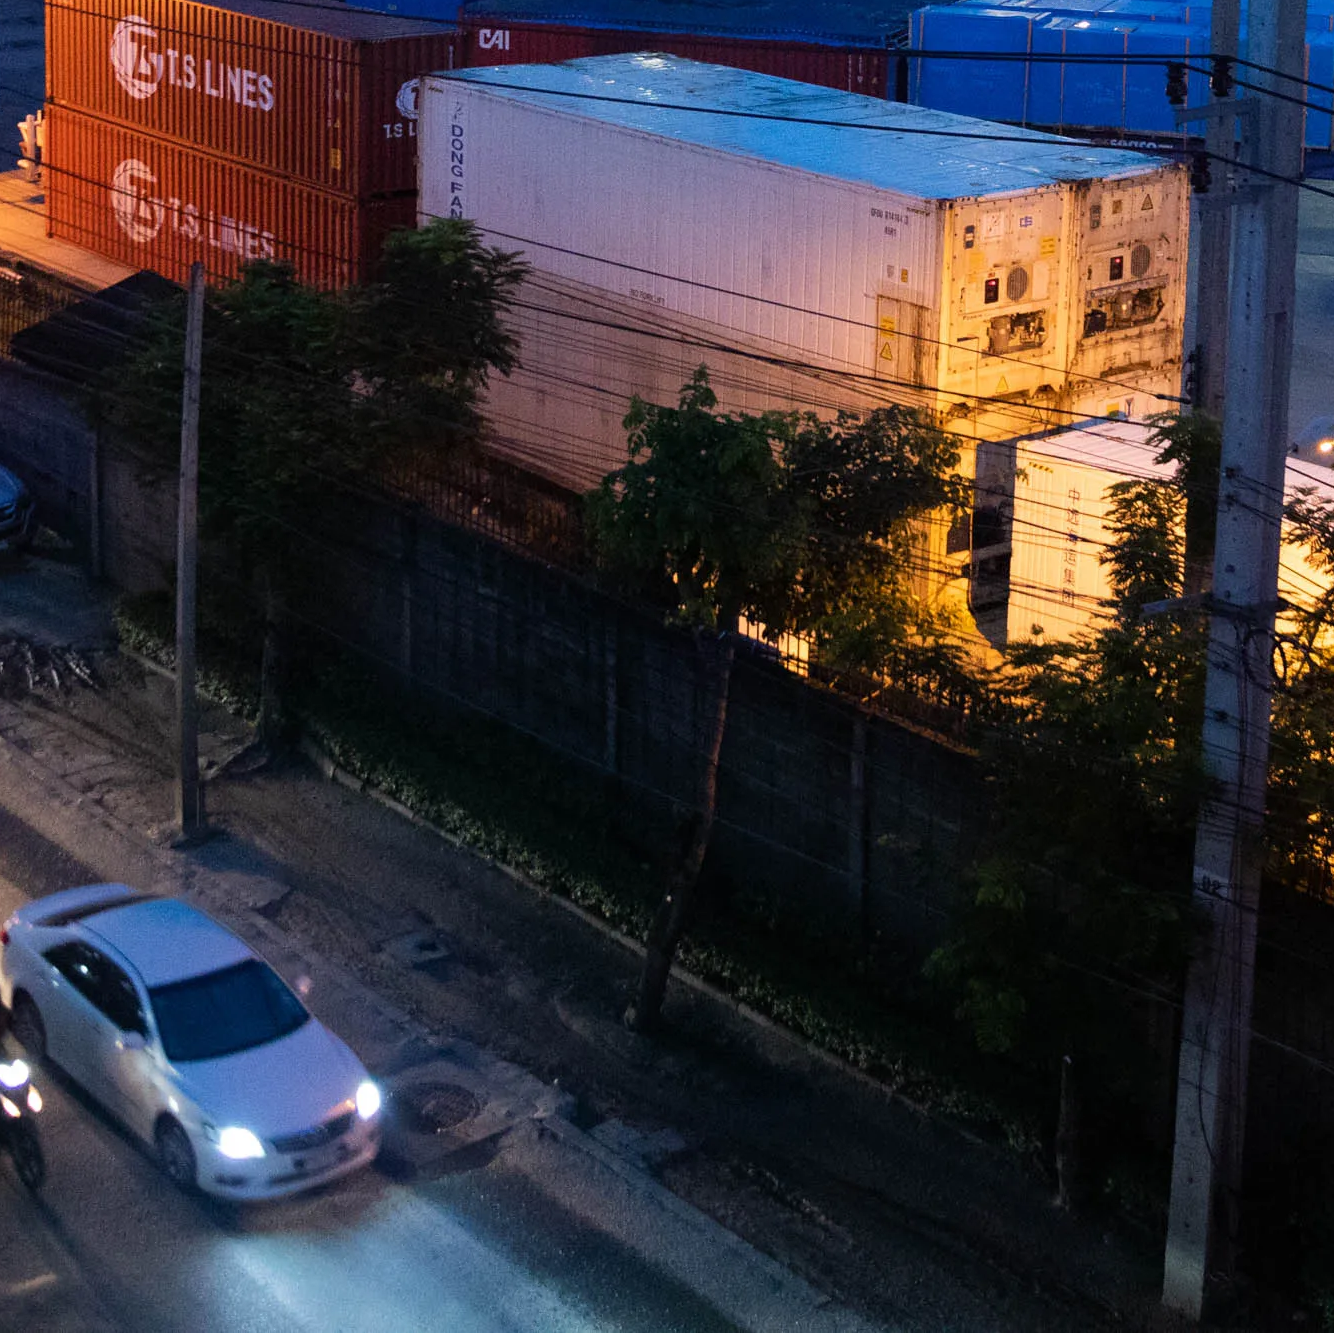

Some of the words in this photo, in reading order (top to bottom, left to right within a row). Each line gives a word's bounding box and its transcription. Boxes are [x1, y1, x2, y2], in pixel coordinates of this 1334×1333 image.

[479, 28, 510, 51] CAI
[167, 48, 202, 93] T.S.
[205, 59, 274, 112] LINES
[450, 124, 464, 178] DONG
[450, 181, 464, 221] FAN
[208, 210, 275, 260] LINES
